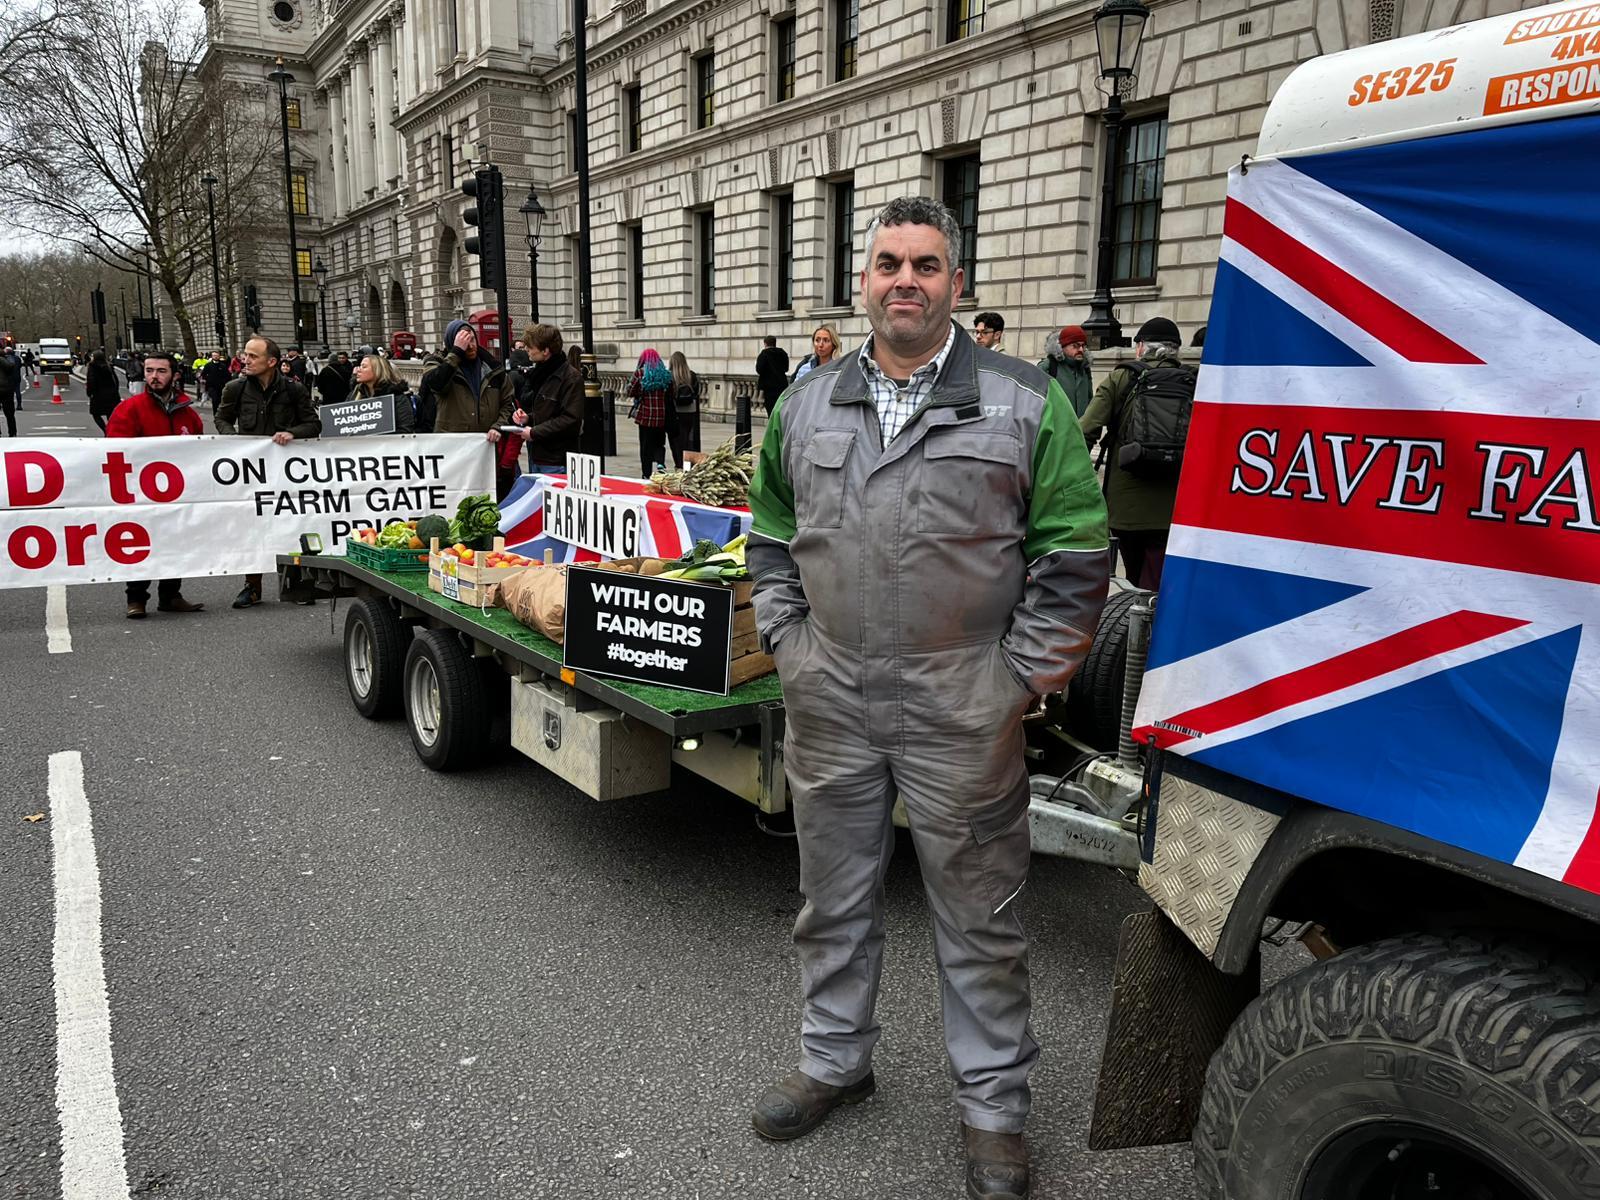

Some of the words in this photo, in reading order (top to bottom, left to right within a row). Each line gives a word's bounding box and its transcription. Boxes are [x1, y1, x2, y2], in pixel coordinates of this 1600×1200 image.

[1347, 57, 1458, 107] SE325
[330, 405, 358, 416] WITH
[360, 401, 382, 411] OUR
[334, 411, 382, 426] FARMERS
[340, 423, 377, 434] #together
[4, 451, 65, 507] D
[102, 451, 185, 504] to
[212, 457, 267, 485] ON
[284, 455, 444, 484] CURRENT
[570, 456, 598, 492] R.I.P.
[1229, 429, 1446, 515] SAVE
[1466, 440, 1600, 533] FA
[254, 488, 351, 516] FARM
[365, 486, 447, 512] GATE
[543, 489, 637, 558] FARMING
[7, 521, 151, 570] ore
[590, 582, 650, 611] WITH
[654, 593, 706, 619] OUR
[596, 611, 702, 647] FARMERS
[606, 642, 689, 672] #together
